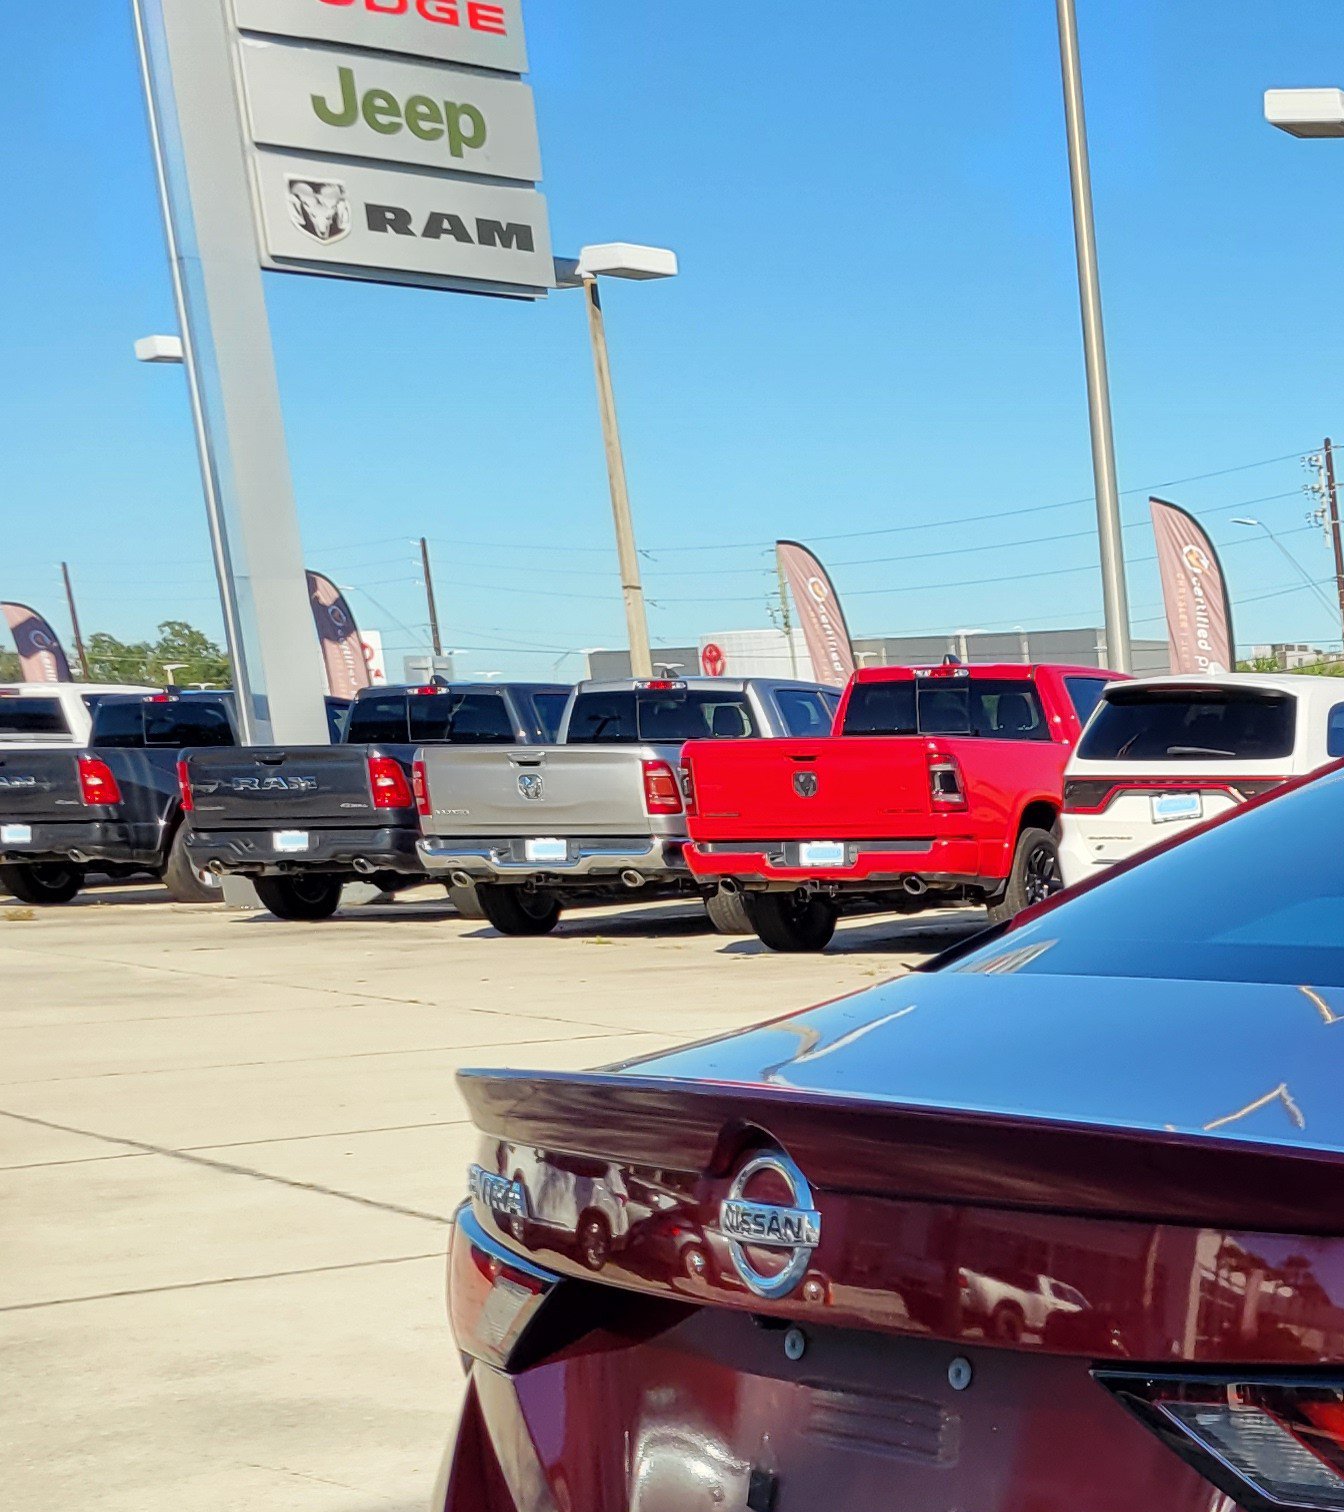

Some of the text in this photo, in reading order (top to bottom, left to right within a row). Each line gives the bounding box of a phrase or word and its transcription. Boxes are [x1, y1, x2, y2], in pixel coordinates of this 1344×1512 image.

[310, 66, 486, 159] Jeep
[364, 202, 535, 253] RAM
[1191, 576, 1212, 651] certified
[232, 777, 318, 791] RAM
[724, 1203, 804, 1245] NISSAN
